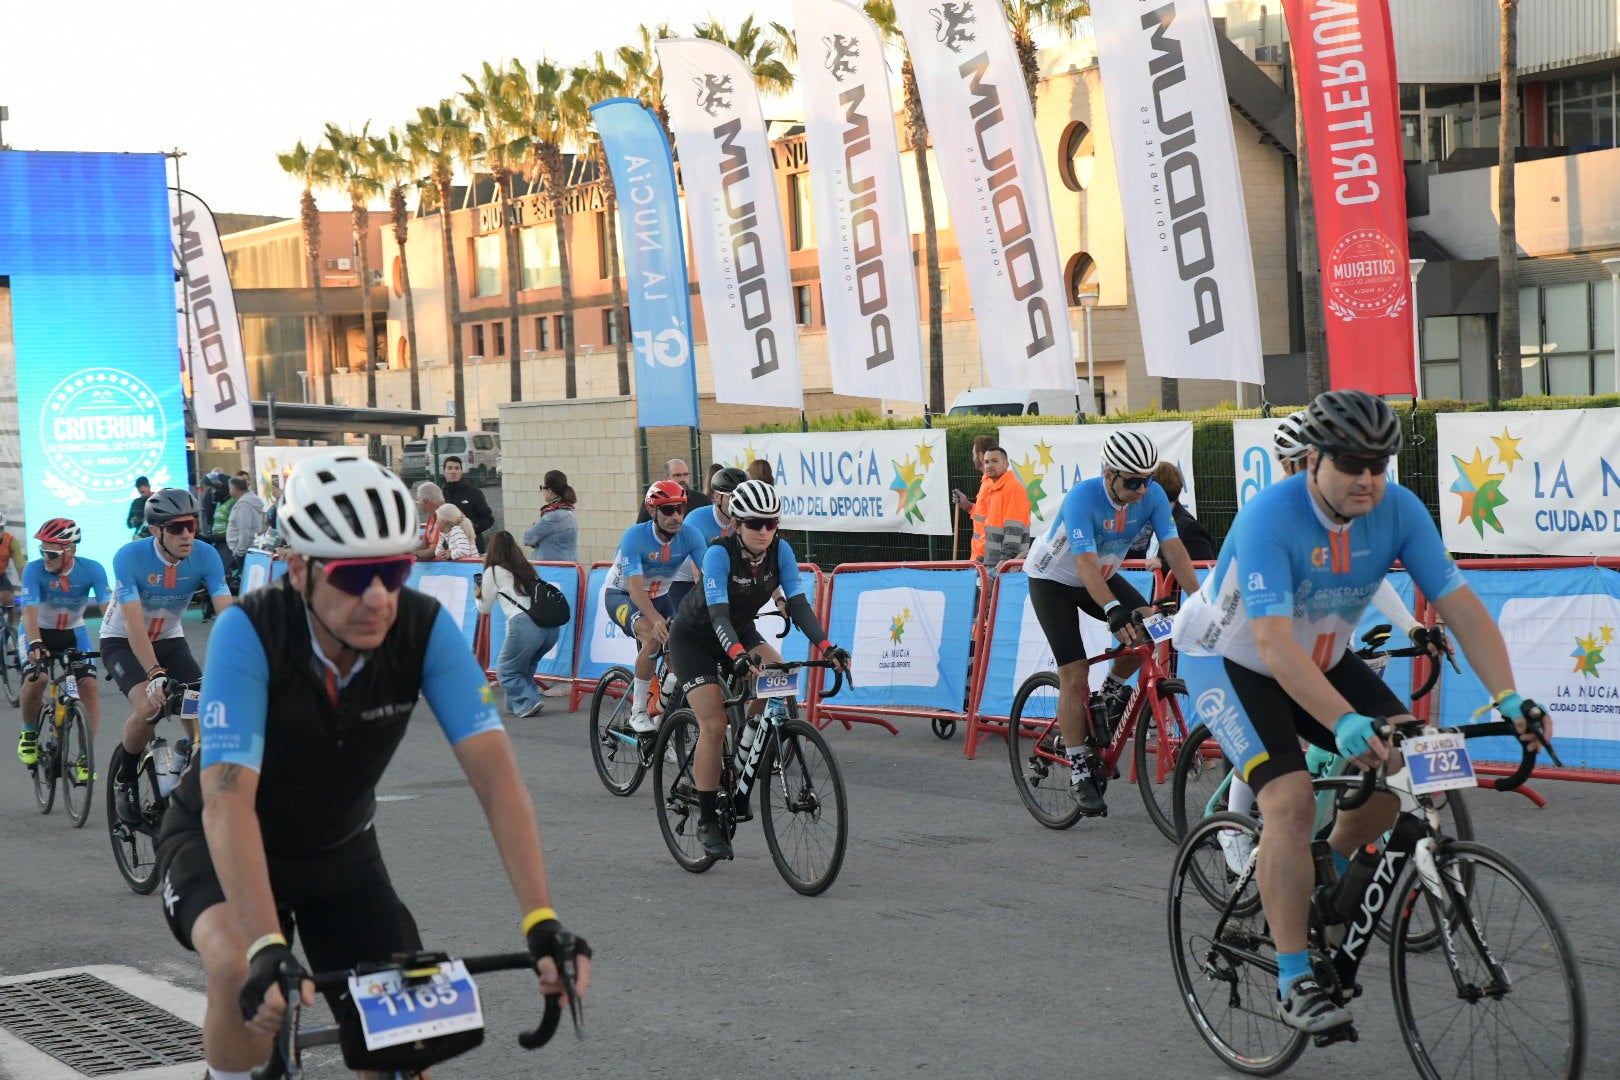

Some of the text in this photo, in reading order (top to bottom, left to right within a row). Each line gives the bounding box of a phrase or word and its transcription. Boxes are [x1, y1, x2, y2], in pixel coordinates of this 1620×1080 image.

[53, 414, 156, 441] CRITERIUM
[1534, 459, 1574, 498] LA
[807, 495, 828, 517] DEL
[830, 495, 884, 518] DEPORTE
[1535, 510, 1607, 532] CIUDAD
[766, 675, 789, 688] 905
[1557, 685, 1571, 698] LA
[1550, 703, 1576, 712] CIUDAD
[1423, 751, 1461, 774] 732
[1343, 850, 1406, 961] KUOTA
[378, 984, 459, 1017] 1165
